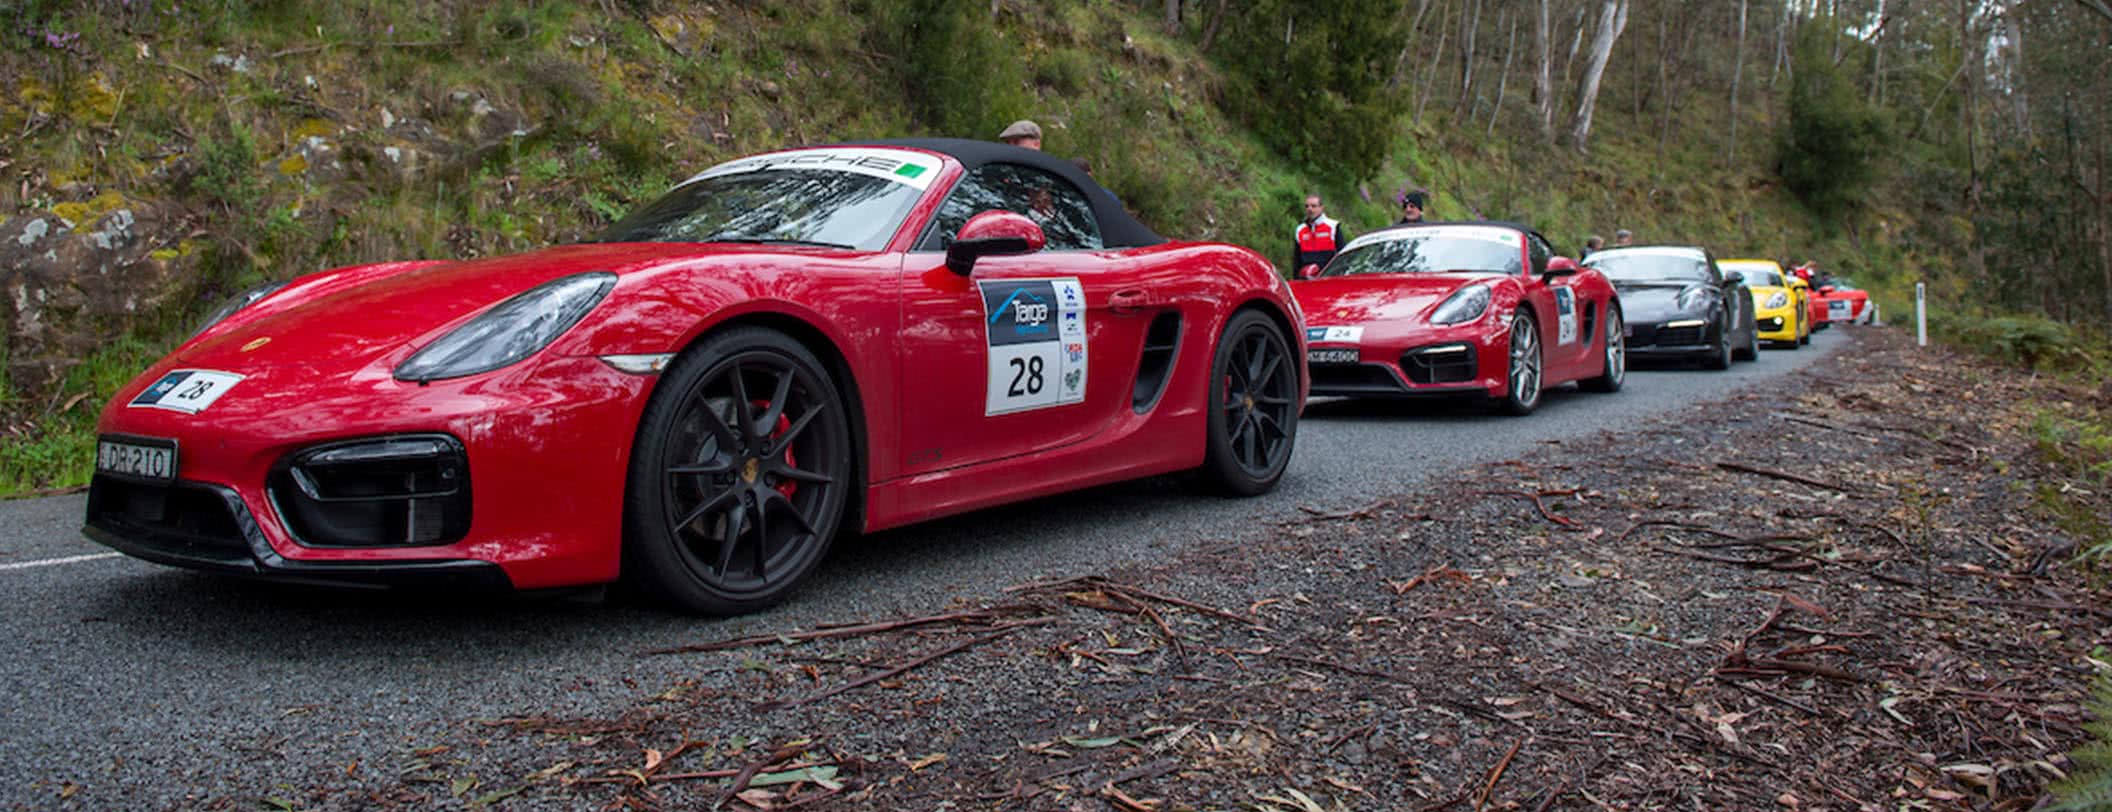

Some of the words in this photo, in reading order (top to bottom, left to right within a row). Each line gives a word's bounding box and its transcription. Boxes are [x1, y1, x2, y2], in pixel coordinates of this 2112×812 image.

[1012, 299, 1049, 327] Targa
[1334, 328, 1351, 338] 24
[1007, 355, 1044, 398] 28
[177, 379, 214, 401] 28
